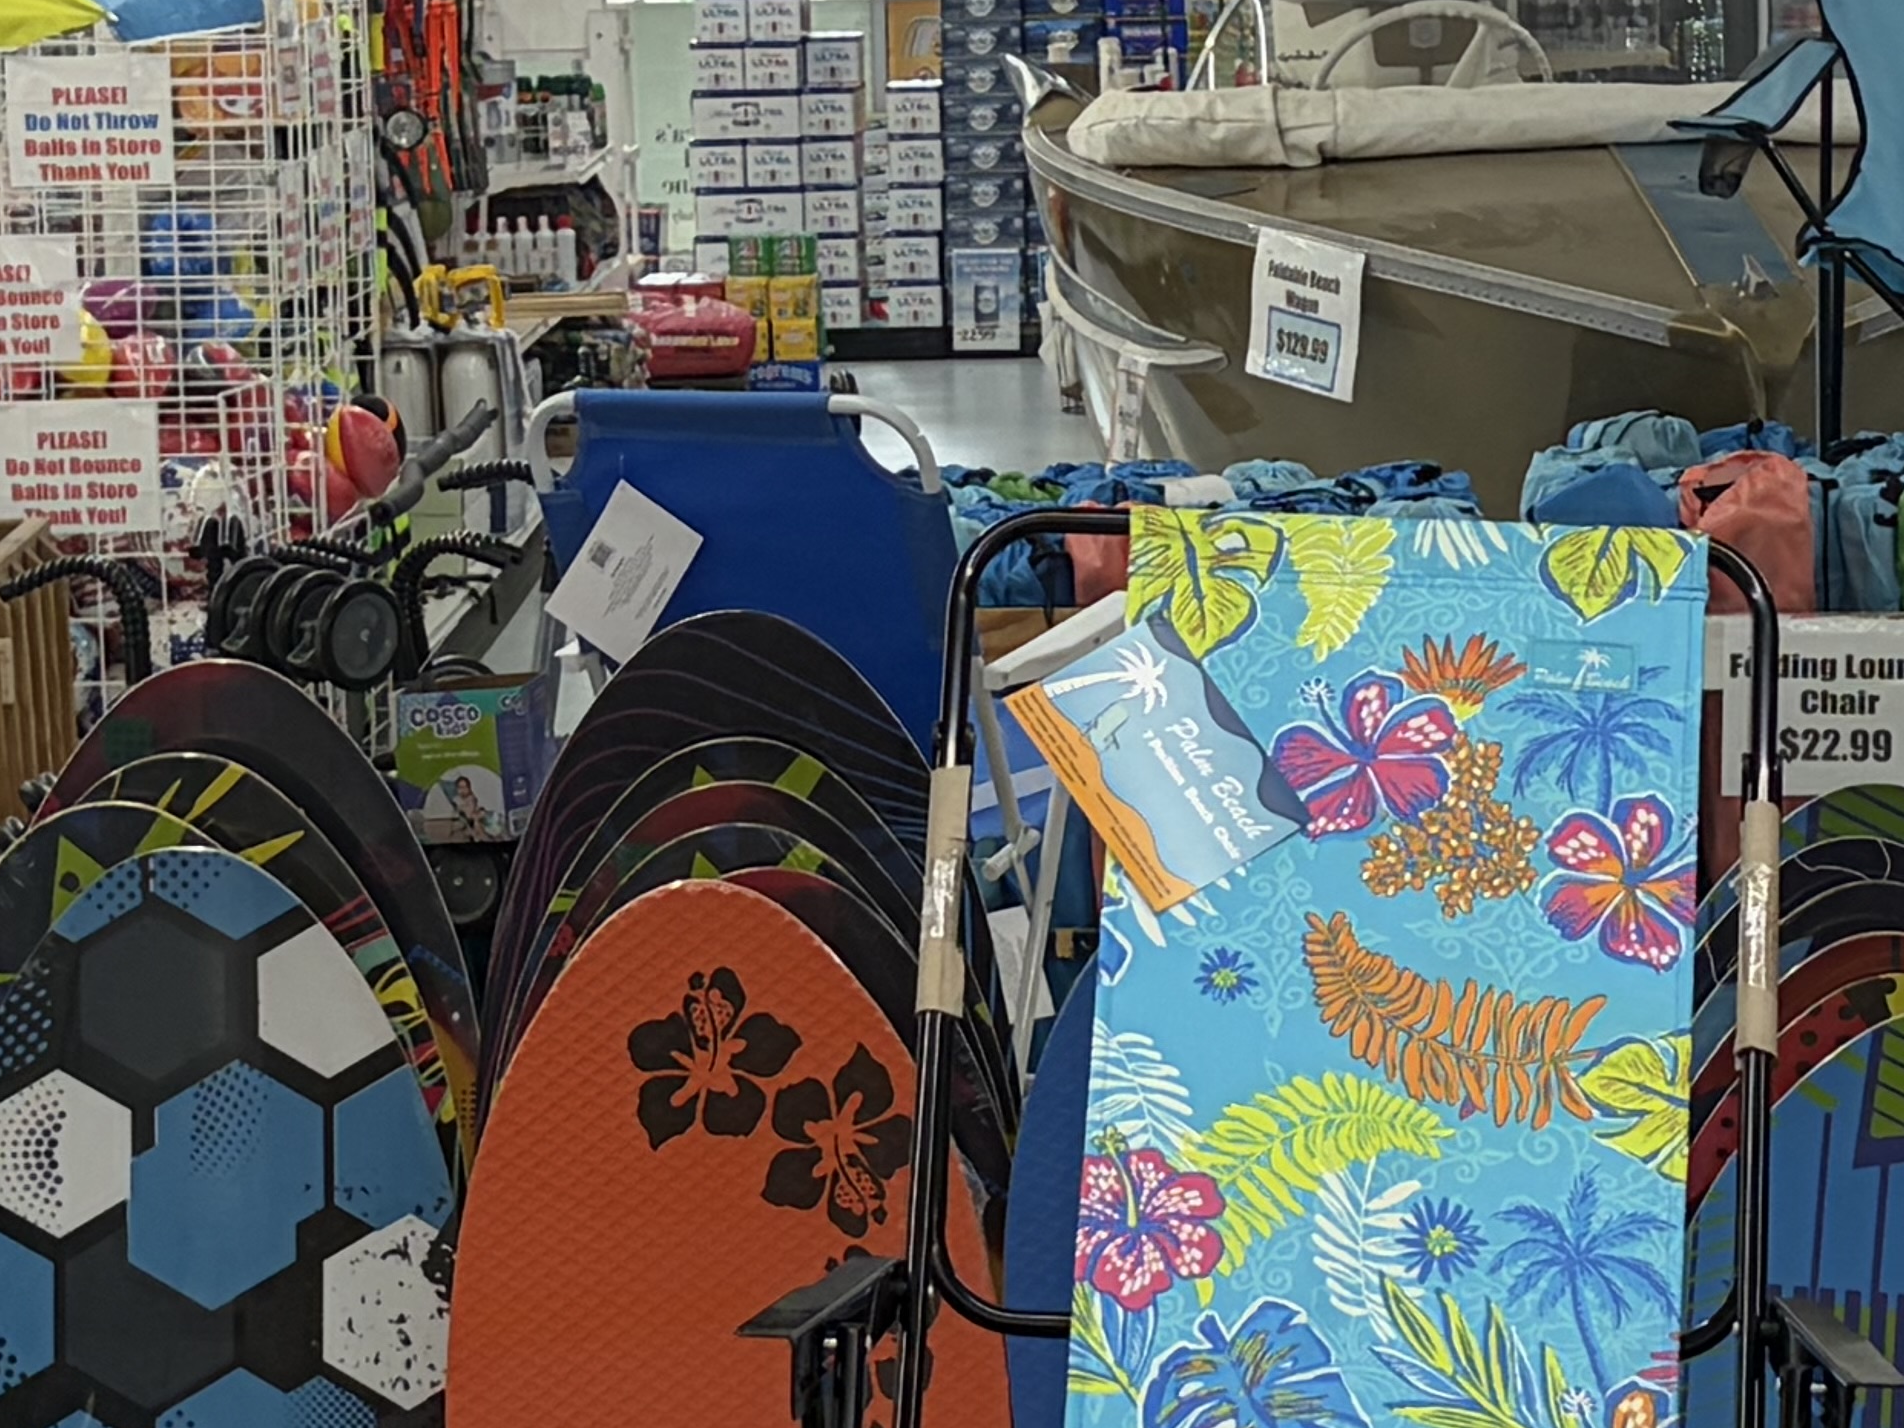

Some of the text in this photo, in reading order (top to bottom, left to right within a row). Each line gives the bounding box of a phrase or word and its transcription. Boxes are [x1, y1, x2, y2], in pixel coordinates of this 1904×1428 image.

[52, 86, 128, 106] PLEASE!
[24, 113, 160, 133] Do Not Throw
[24, 138, 78, 158] Balls
[106, 138, 163, 156] Store
[39, 162, 151, 182] Thank You!
[10, 313, 62, 331] Store
[10, 337, 51, 355] You!
[1276, 328, 1330, 364] $129.99
[37, 430, 108, 451] PLEASE!
[5, 455, 142, 477] Do Not Bounce
[11, 484, 60, 503] Balls
[86, 482, 138, 500] Store
[86, 506, 128, 525] You!
[1729, 653, 1838, 682] Foding
[1800, 689, 1881, 715] Chair
[1779, 726, 1893, 763] $22.99
[1165, 717, 1274, 841] Palm Beach
